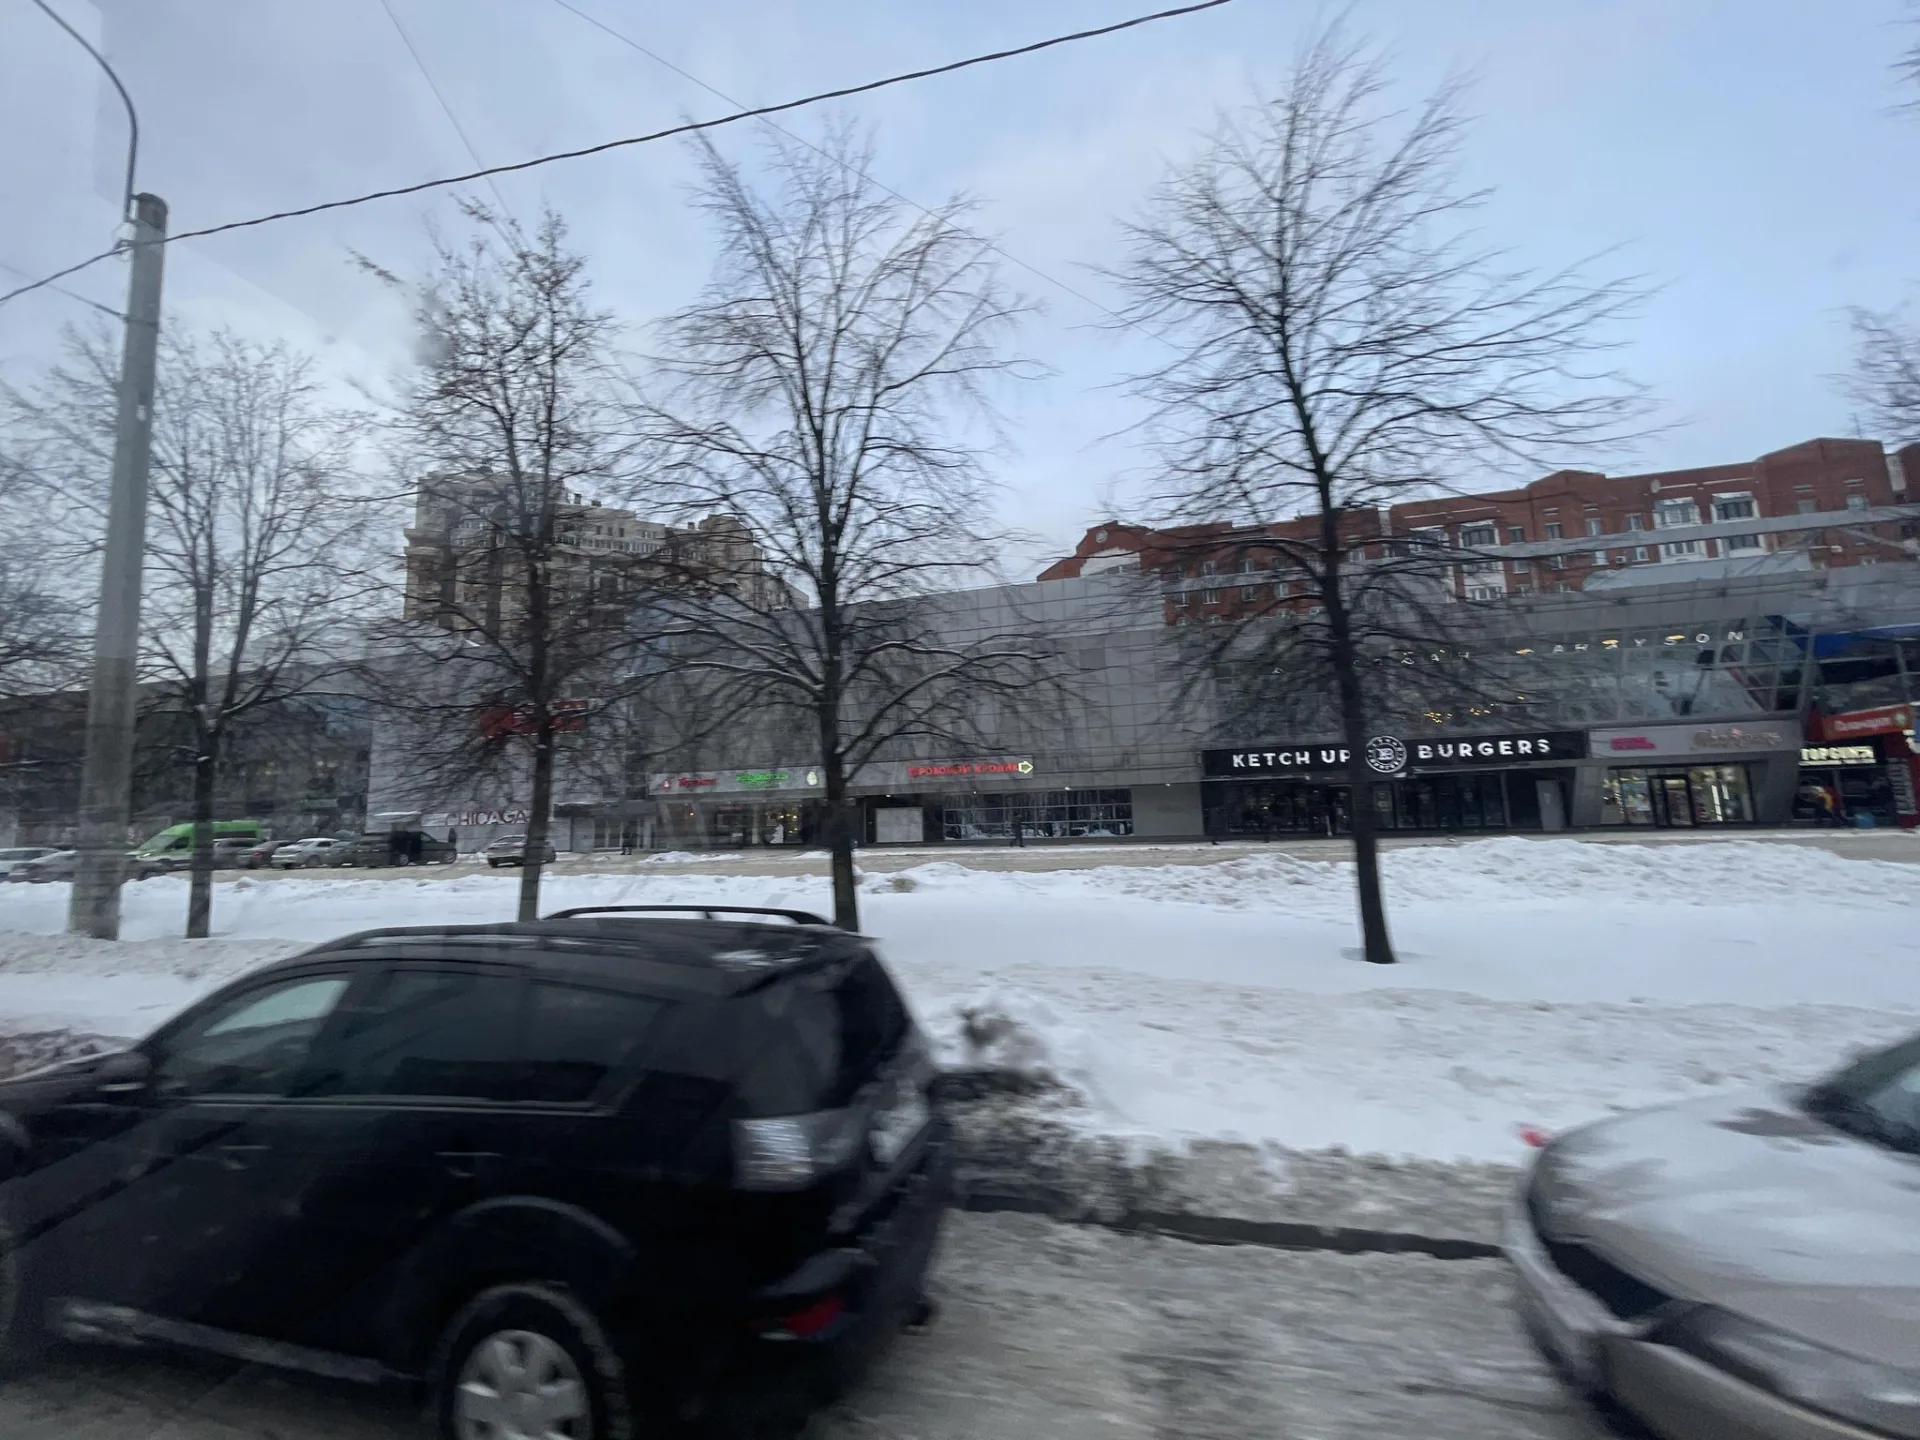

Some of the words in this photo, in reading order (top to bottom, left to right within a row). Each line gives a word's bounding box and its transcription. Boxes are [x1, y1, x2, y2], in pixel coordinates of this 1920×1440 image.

[1232, 751, 1310, 767] KETCH
[1320, 749, 1351, 763] UP
[1417, 738, 1551, 760] BURGERS
